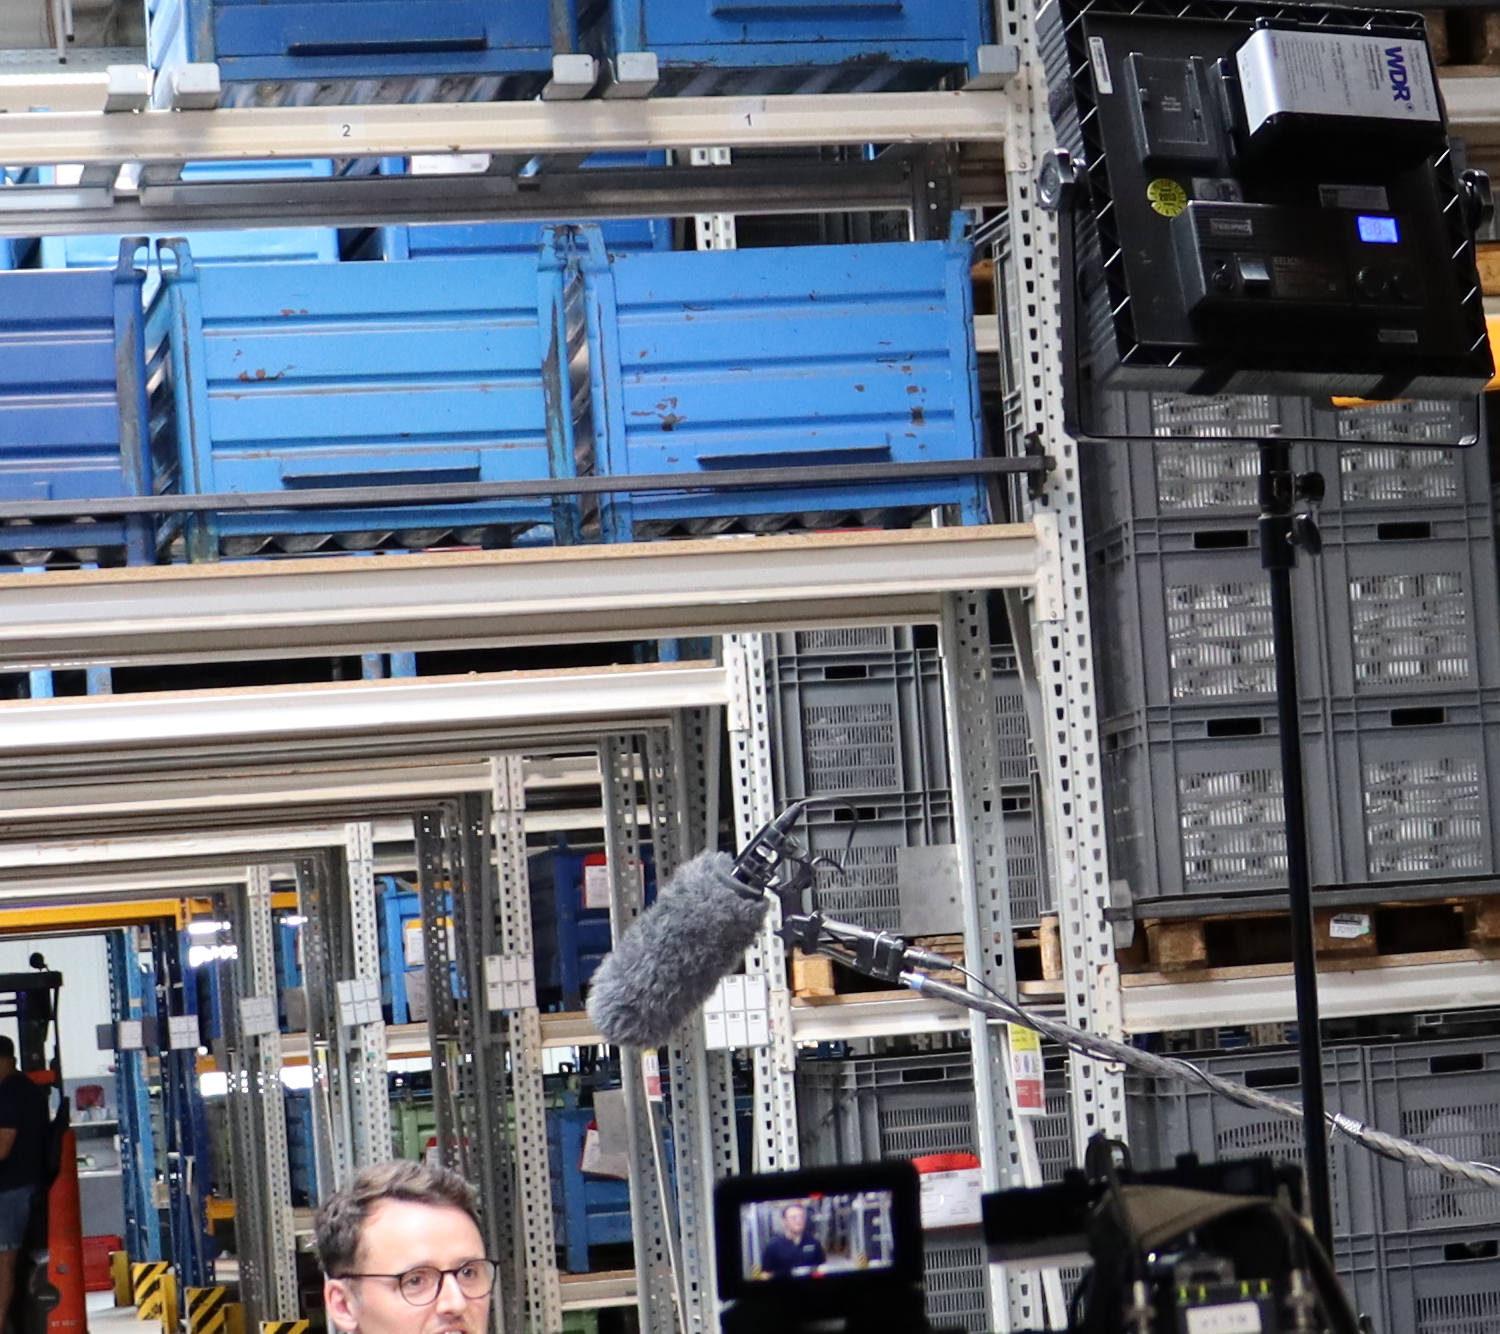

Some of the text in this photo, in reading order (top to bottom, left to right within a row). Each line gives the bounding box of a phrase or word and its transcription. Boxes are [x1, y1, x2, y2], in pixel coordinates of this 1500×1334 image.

[1385, 45, 1411, 102] WDR
[744, 113, 752, 126] 1
[342, 124, 351, 137] 2
